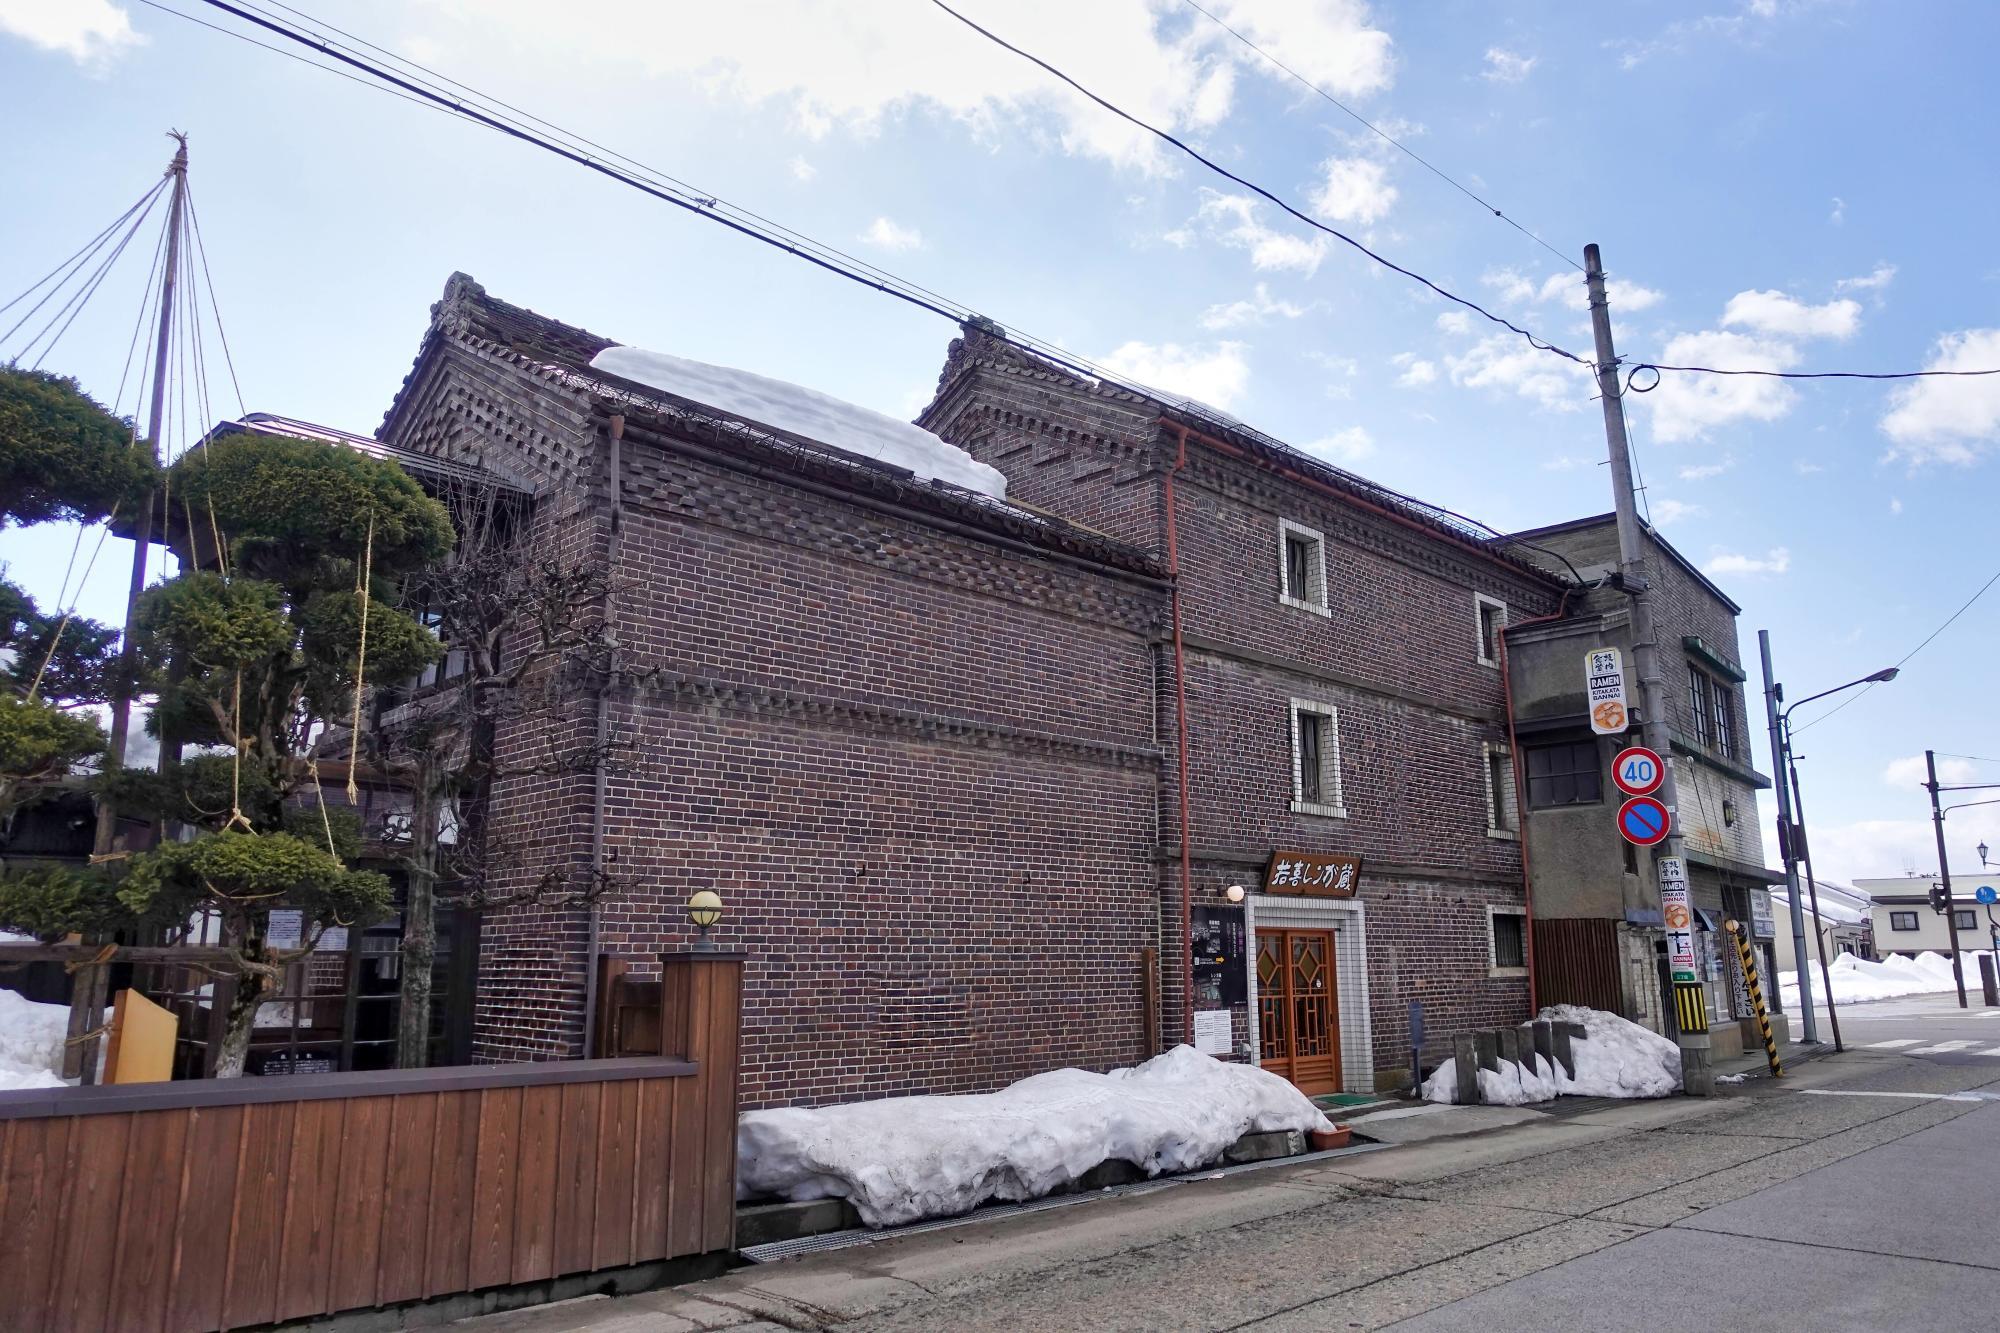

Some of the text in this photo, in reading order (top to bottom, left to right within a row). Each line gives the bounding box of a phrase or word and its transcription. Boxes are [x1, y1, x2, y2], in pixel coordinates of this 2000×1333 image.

[1591, 676, 1620, 689] RAMEN
[1592, 687, 1620, 696] KITAKATA
[1593, 692, 1620, 701] BANNAI
[1624, 761, 1652, 782] 40
